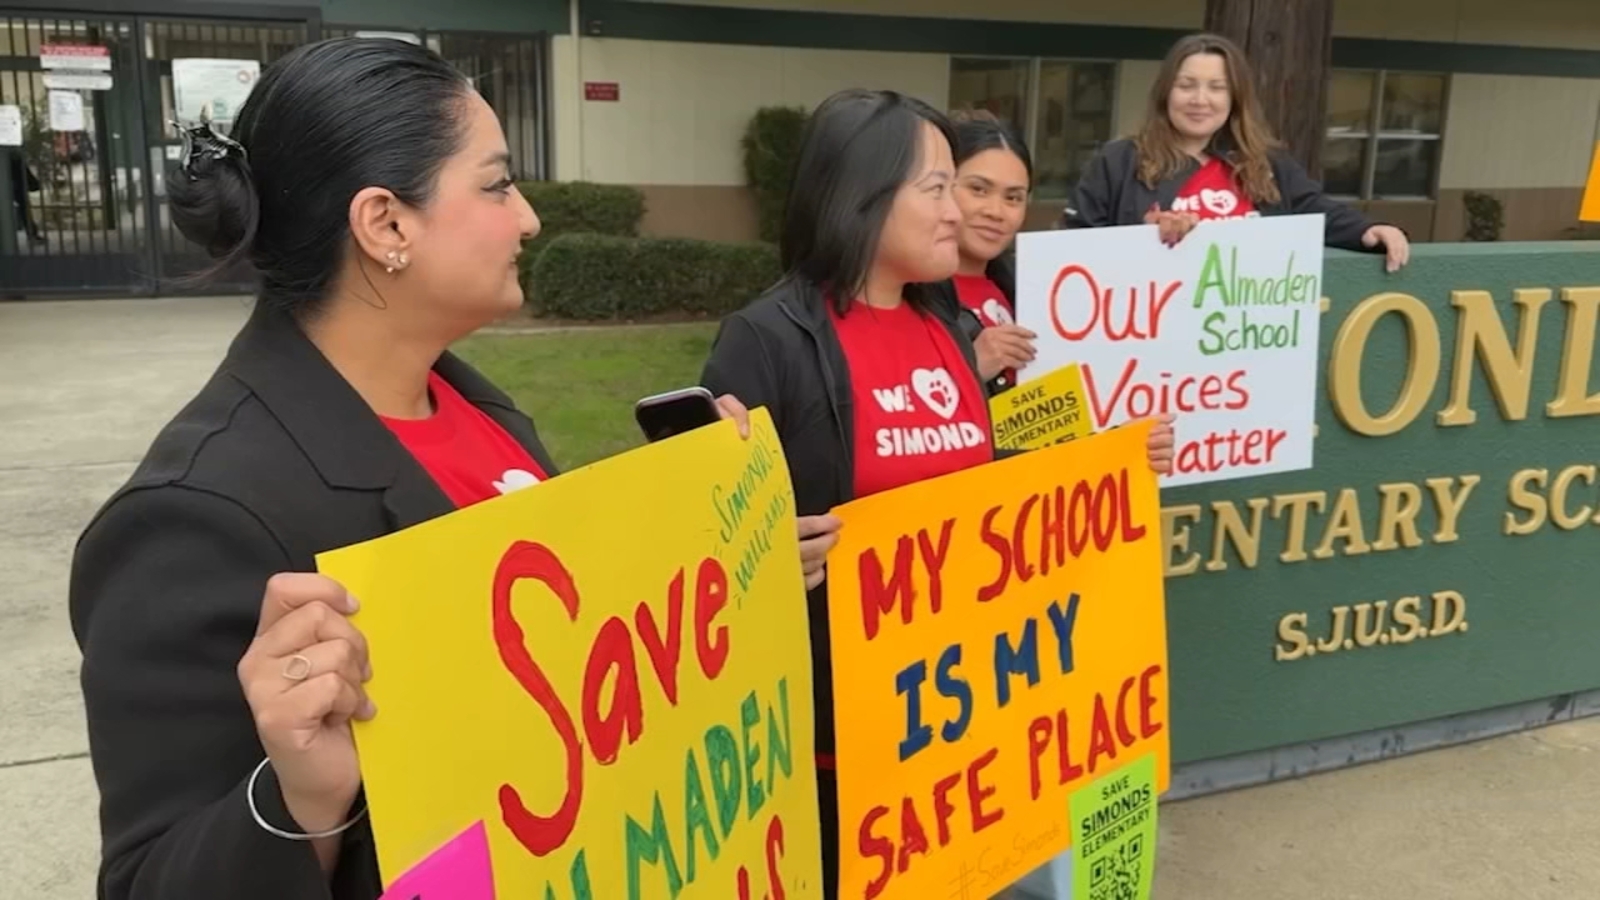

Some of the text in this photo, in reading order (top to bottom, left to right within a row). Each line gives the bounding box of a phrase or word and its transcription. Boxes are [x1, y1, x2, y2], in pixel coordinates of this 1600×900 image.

[1049, 264, 1184, 342] Our
[1193, 243, 1318, 309] Almaden
[1198, 309, 1299, 356] School
[995, 390, 1078, 440] SIMONDS
[1011, 385, 1047, 408] SAVE
[1080, 358, 1250, 428] Voices
[1167, 426, 1287, 477] atter
[858, 467, 1147, 641] MY SCHOOL
[1161, 464, 1600, 579] ENTARY SC
[1275, 590, 1469, 661] S.J.U.S.D.
[492, 540, 729, 857] Save
[896, 592, 1081, 762] IS MY
[858, 747, 1005, 900] SAFE
[1028, 664, 1163, 801] PLACE
[1082, 783, 1151, 838] SIMONDS
[1102, 775, 1130, 800] SAVE
[1082, 808, 1151, 859] ELEMENTARY
